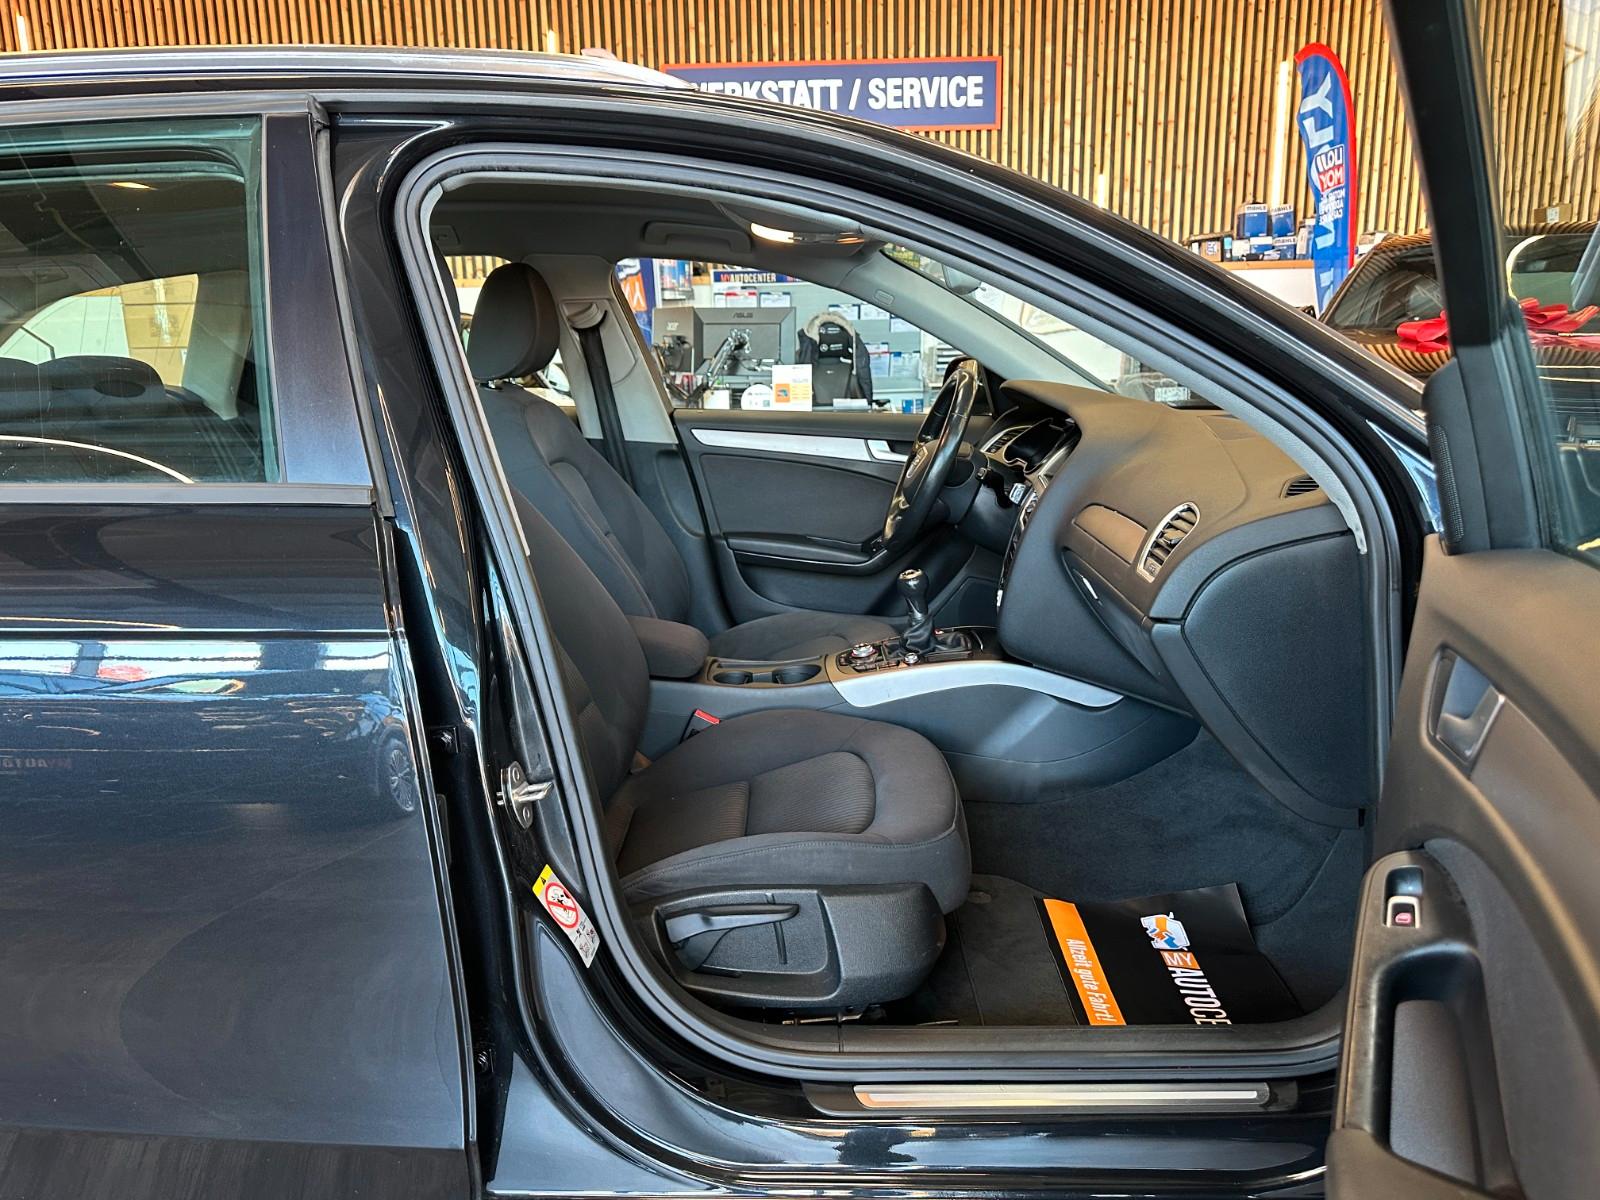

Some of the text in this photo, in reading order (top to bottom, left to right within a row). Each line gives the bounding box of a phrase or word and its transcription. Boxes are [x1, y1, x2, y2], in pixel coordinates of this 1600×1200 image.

[691, 79, 842, 110] KSTATT
[868, 76, 984, 109] SERVICE
[1163, 951, 1193, 967] MY
[1066, 938, 1118, 1022] Allzeit gute Fahrt!
